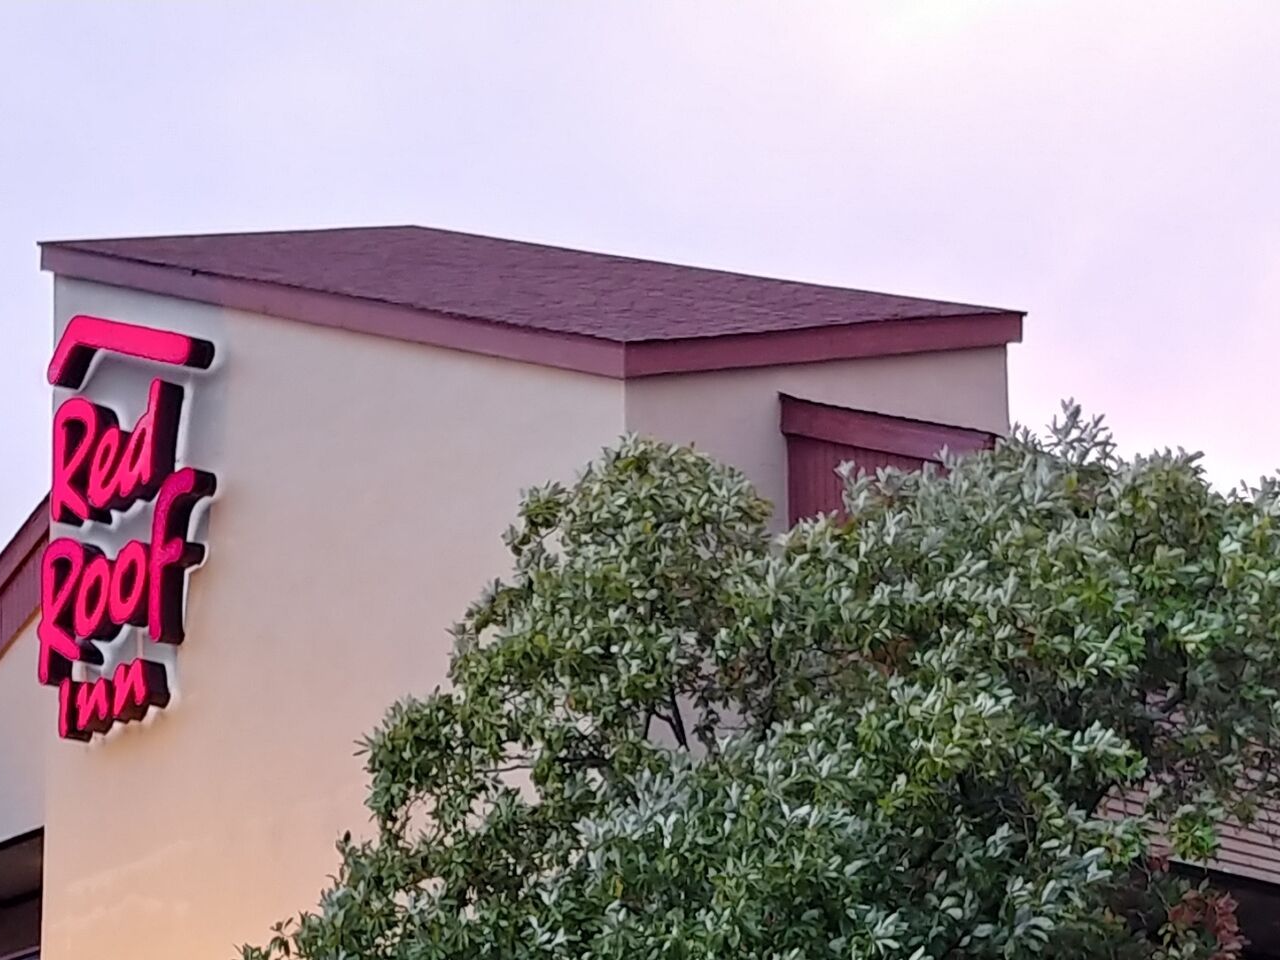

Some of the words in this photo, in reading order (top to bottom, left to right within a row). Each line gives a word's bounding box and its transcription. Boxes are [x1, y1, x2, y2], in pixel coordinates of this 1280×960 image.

[51, 377, 168, 523] Red
[37, 466, 197, 686] Roof
[58, 657, 150, 739] Inn
